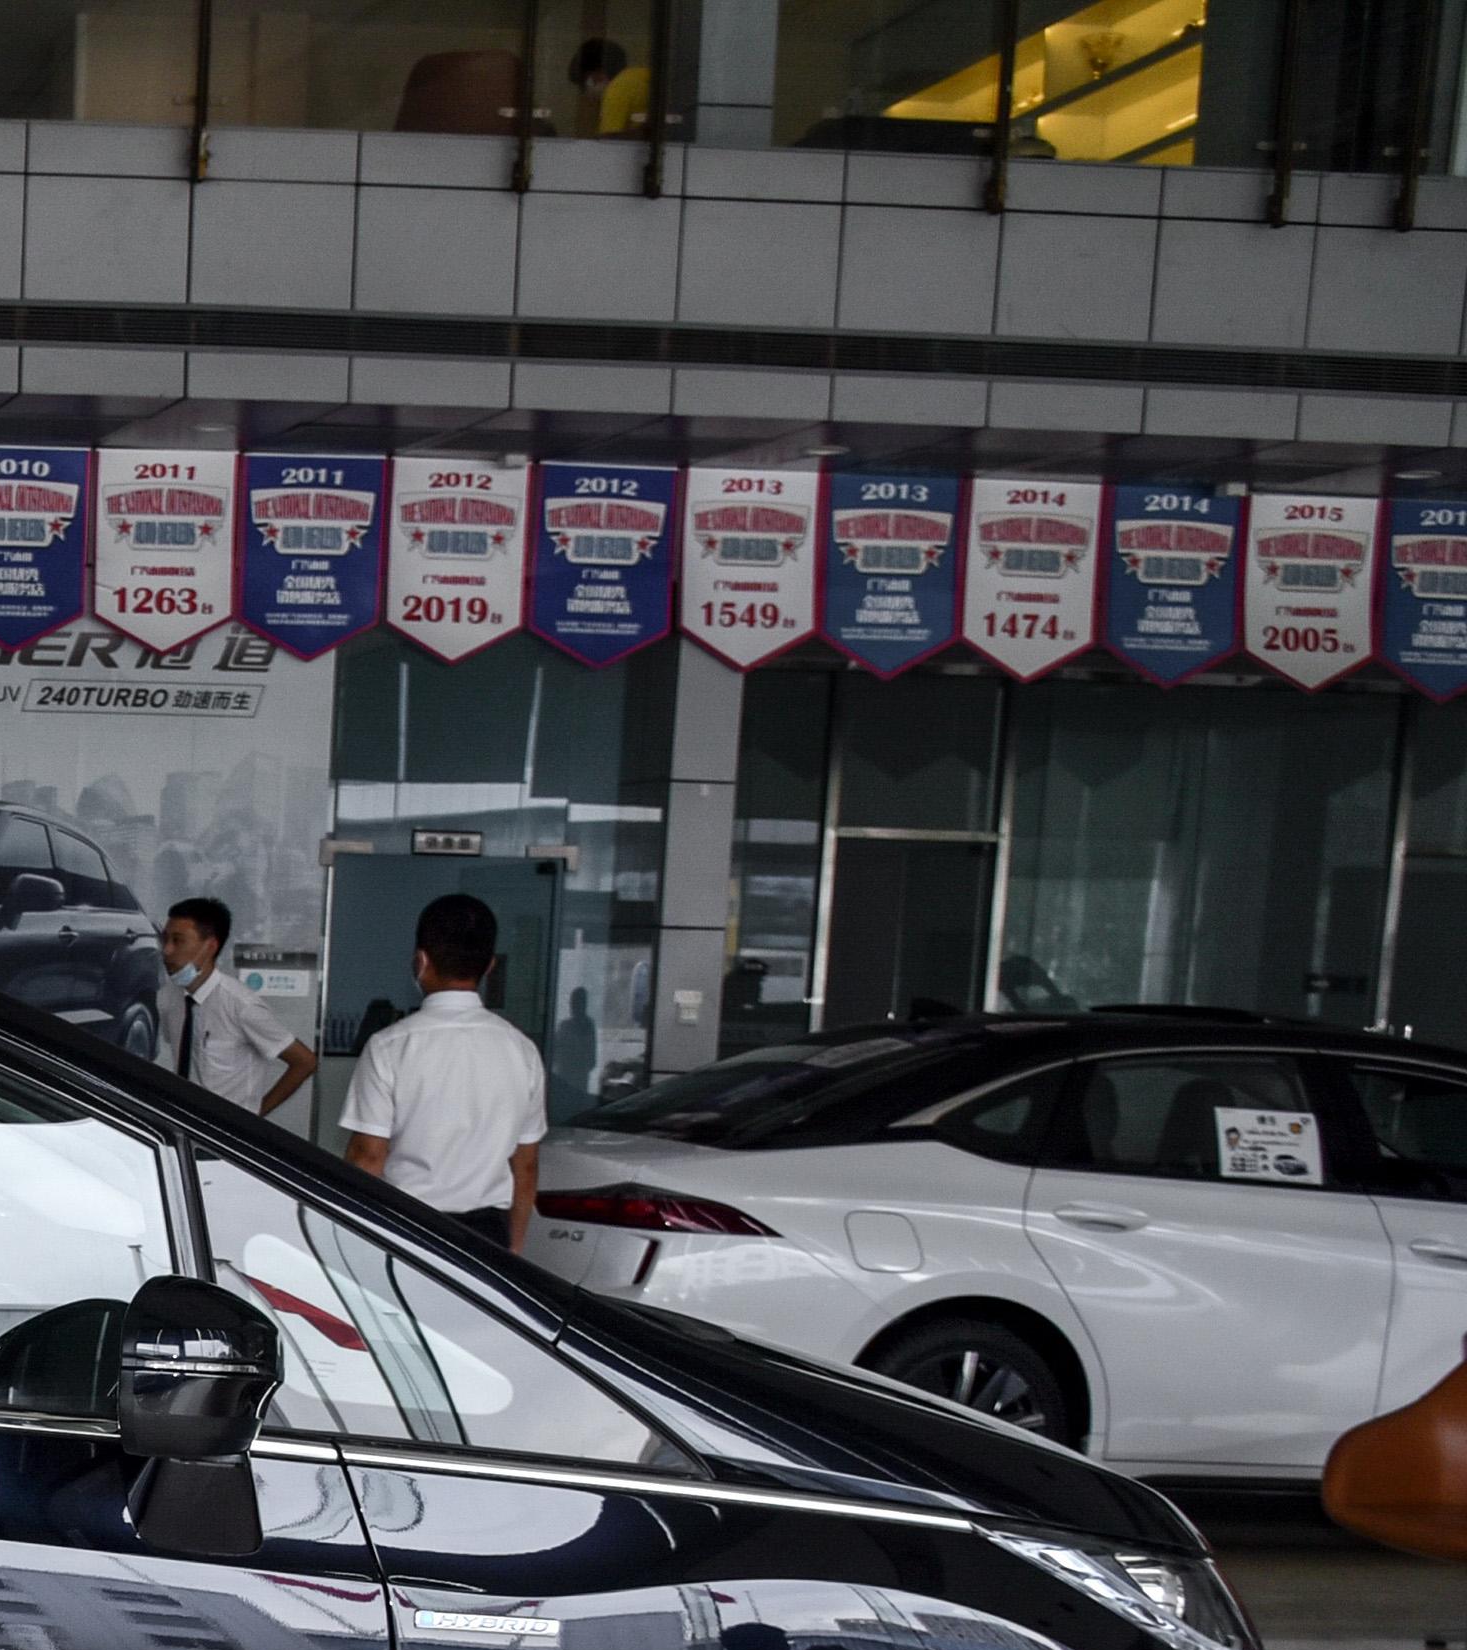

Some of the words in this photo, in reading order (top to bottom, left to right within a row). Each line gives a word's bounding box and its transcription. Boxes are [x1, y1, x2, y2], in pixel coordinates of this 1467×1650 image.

[134, 464, 196, 480] 2011
[281, 468, 344, 485] 2011
[429, 472, 492, 489] 2012
[575, 477, 639, 496] 2012
[722, 479, 784, 495] 2013
[861, 483, 929, 501] 2013
[1007, 489, 1066, 507] 2014
[1144, 494, 1211, 514] 2014
[1284, 505, 1344, 522] 2015
[1420, 509, 1467, 526] 201
[37, 686, 168, 709] 240TURBO
[172, 690, 251, 711] 劲速而生
[437, 1615, 549, 1632] HYBRID
